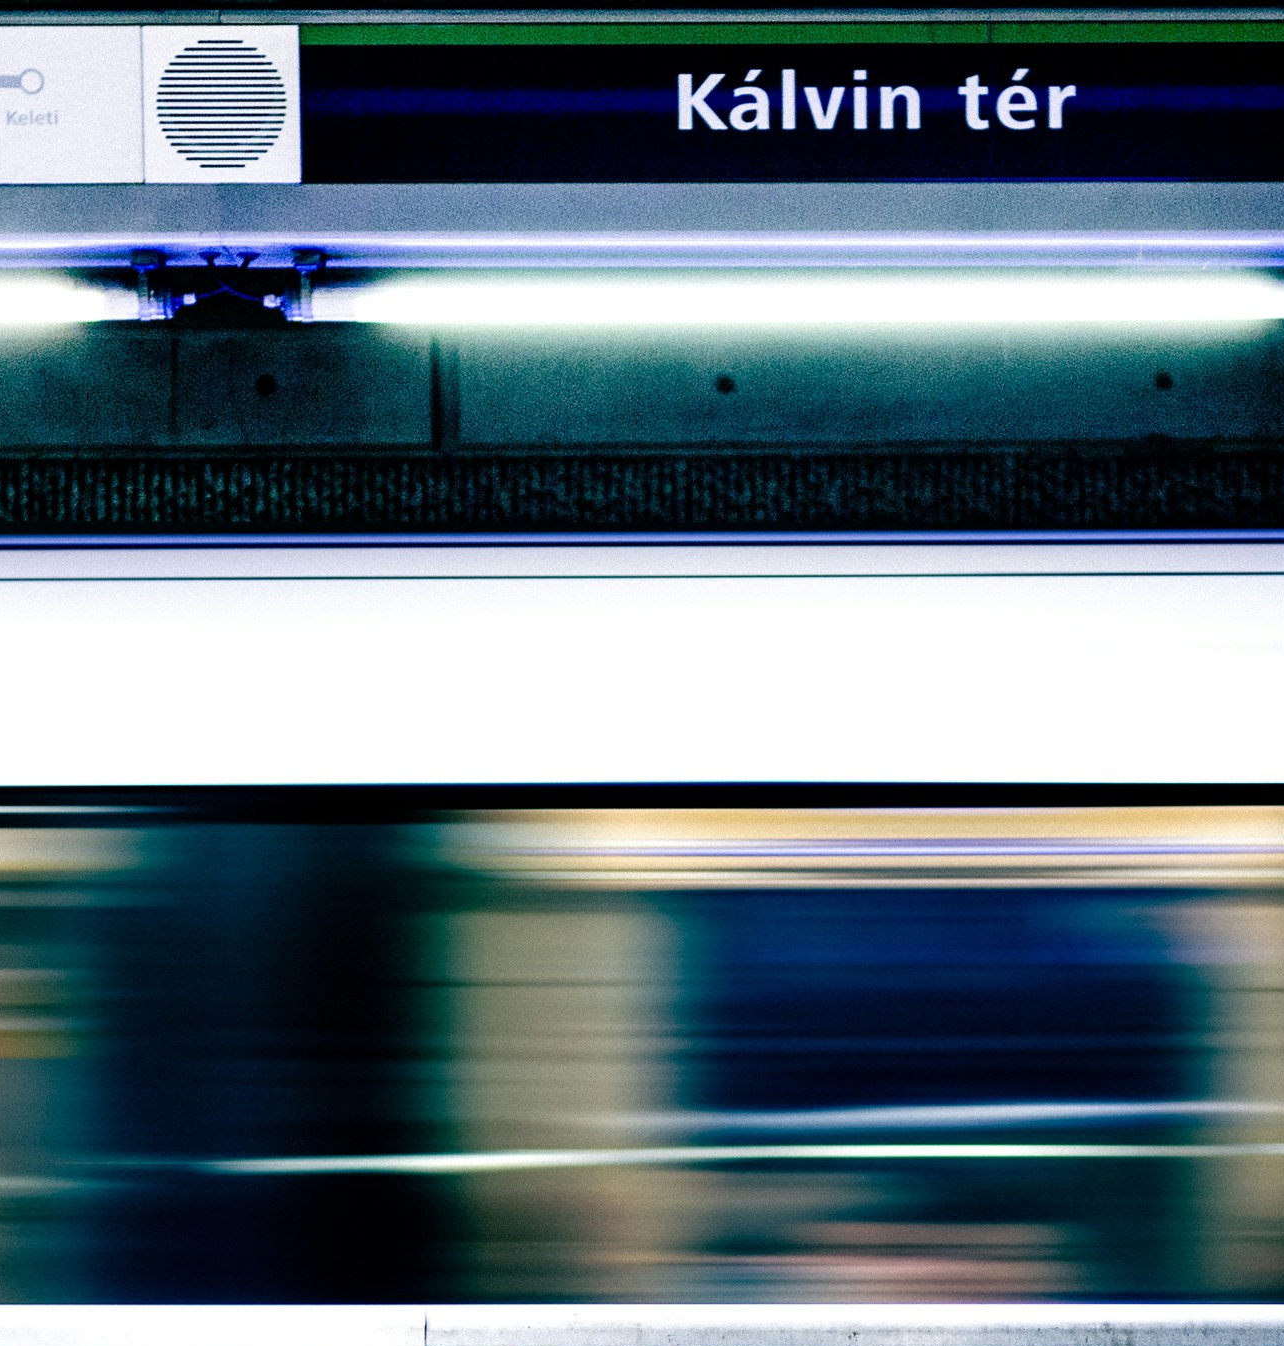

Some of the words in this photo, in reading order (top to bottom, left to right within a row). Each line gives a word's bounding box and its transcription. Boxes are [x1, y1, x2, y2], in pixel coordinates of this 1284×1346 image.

[5, 109, 59, 126] Keleti
[677, 68, 921, 131] Kálvin
[957, 68, 1077, 130] tér
